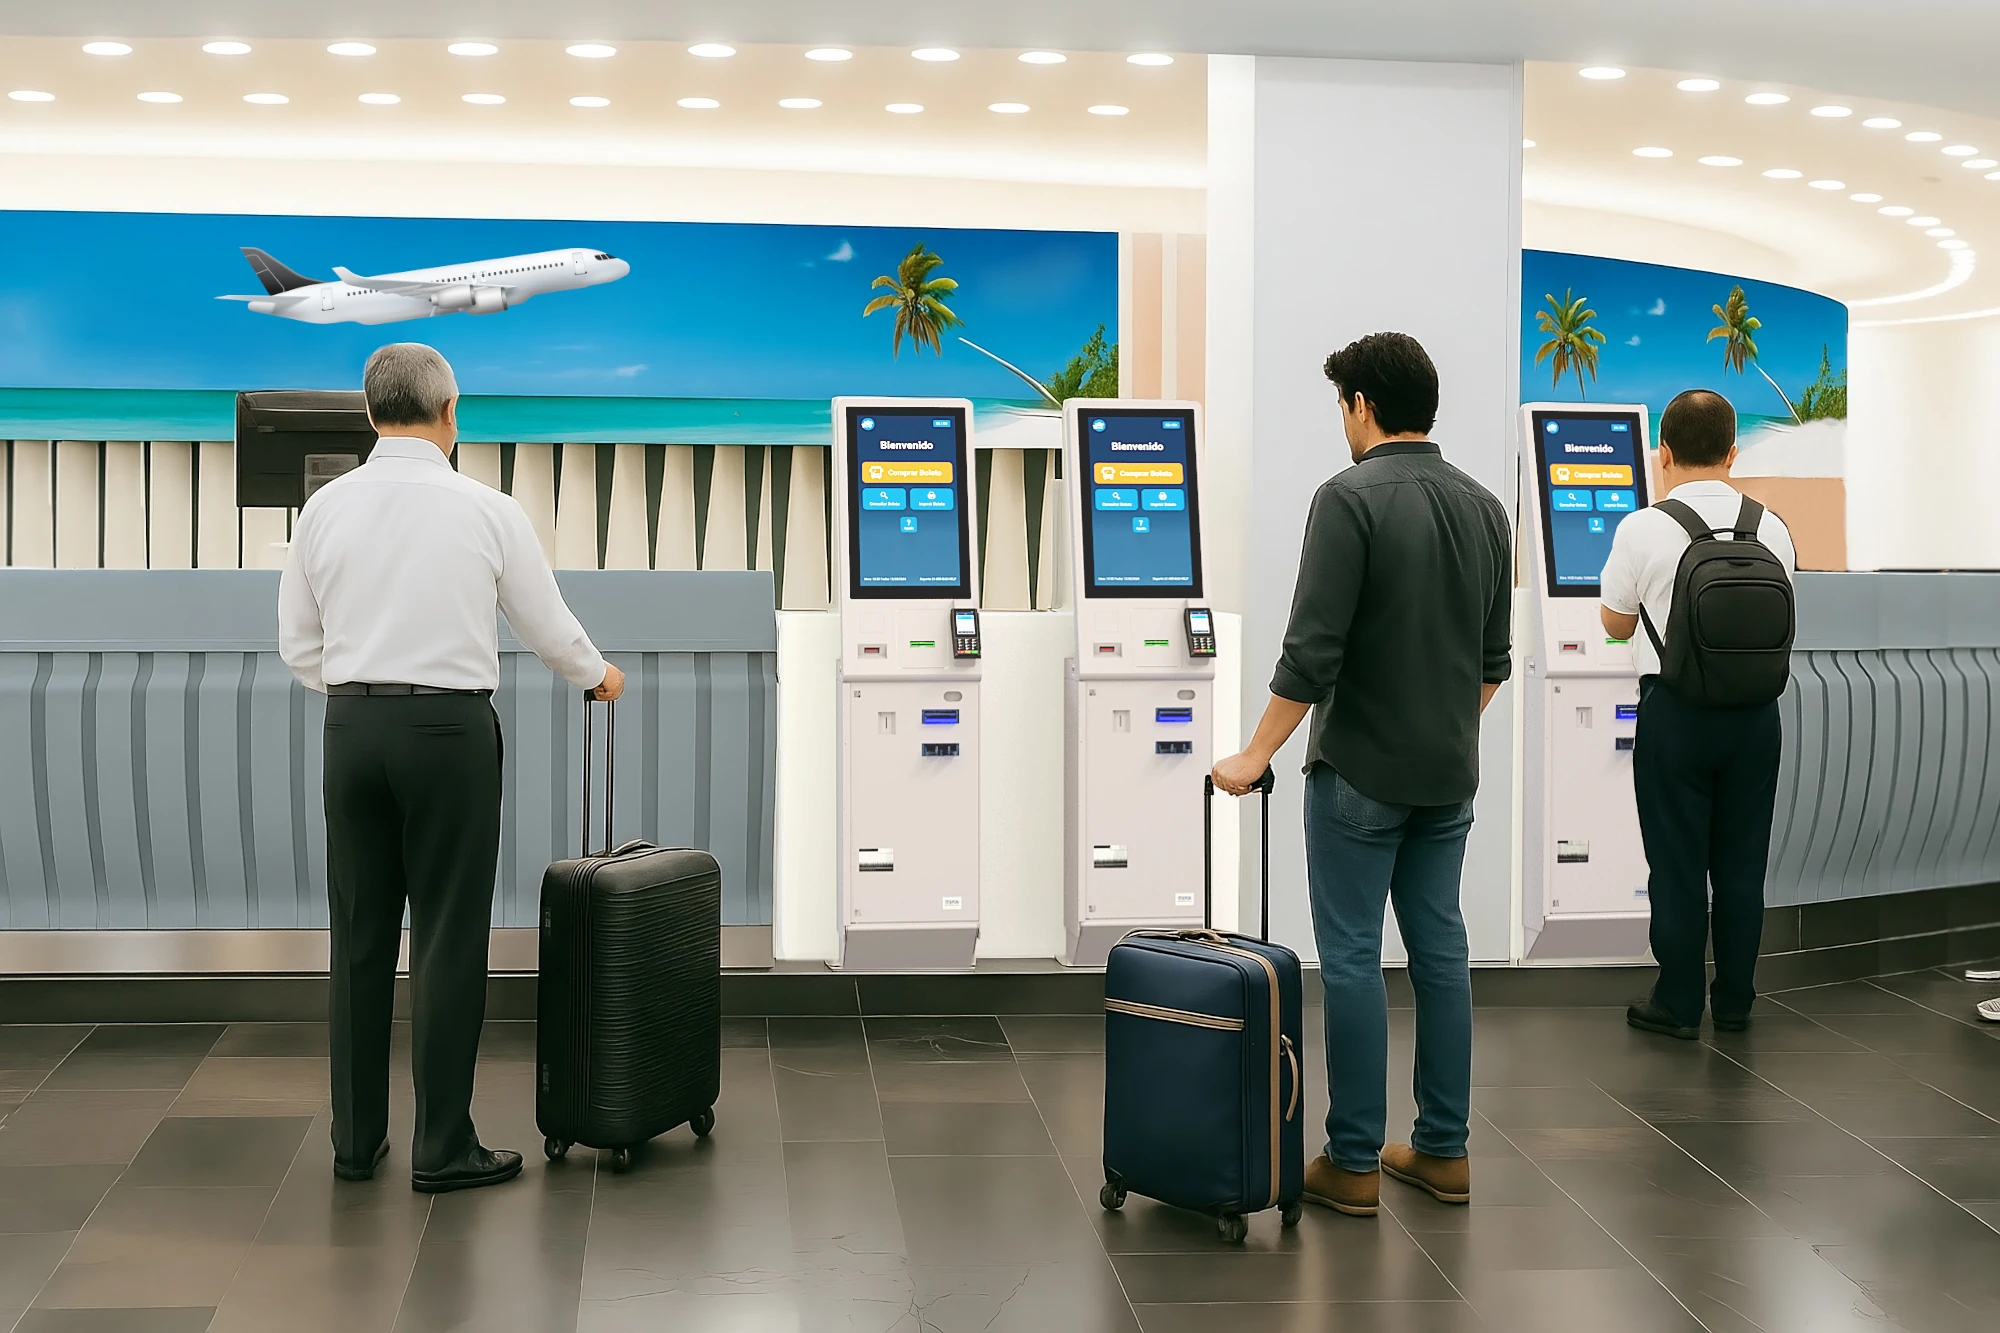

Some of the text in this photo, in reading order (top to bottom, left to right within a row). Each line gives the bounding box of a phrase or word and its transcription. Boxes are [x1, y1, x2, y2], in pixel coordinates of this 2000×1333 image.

[880, 441, 934, 450] Bienvenido
[1111, 442, 1164, 451] Bienvenido
[1564, 443, 1614, 453] Bienvenido
[888, 469, 918, 477] Comprar
[1119, 470, 1150, 478] Comprar
[1574, 471, 1601, 479] Comprar
